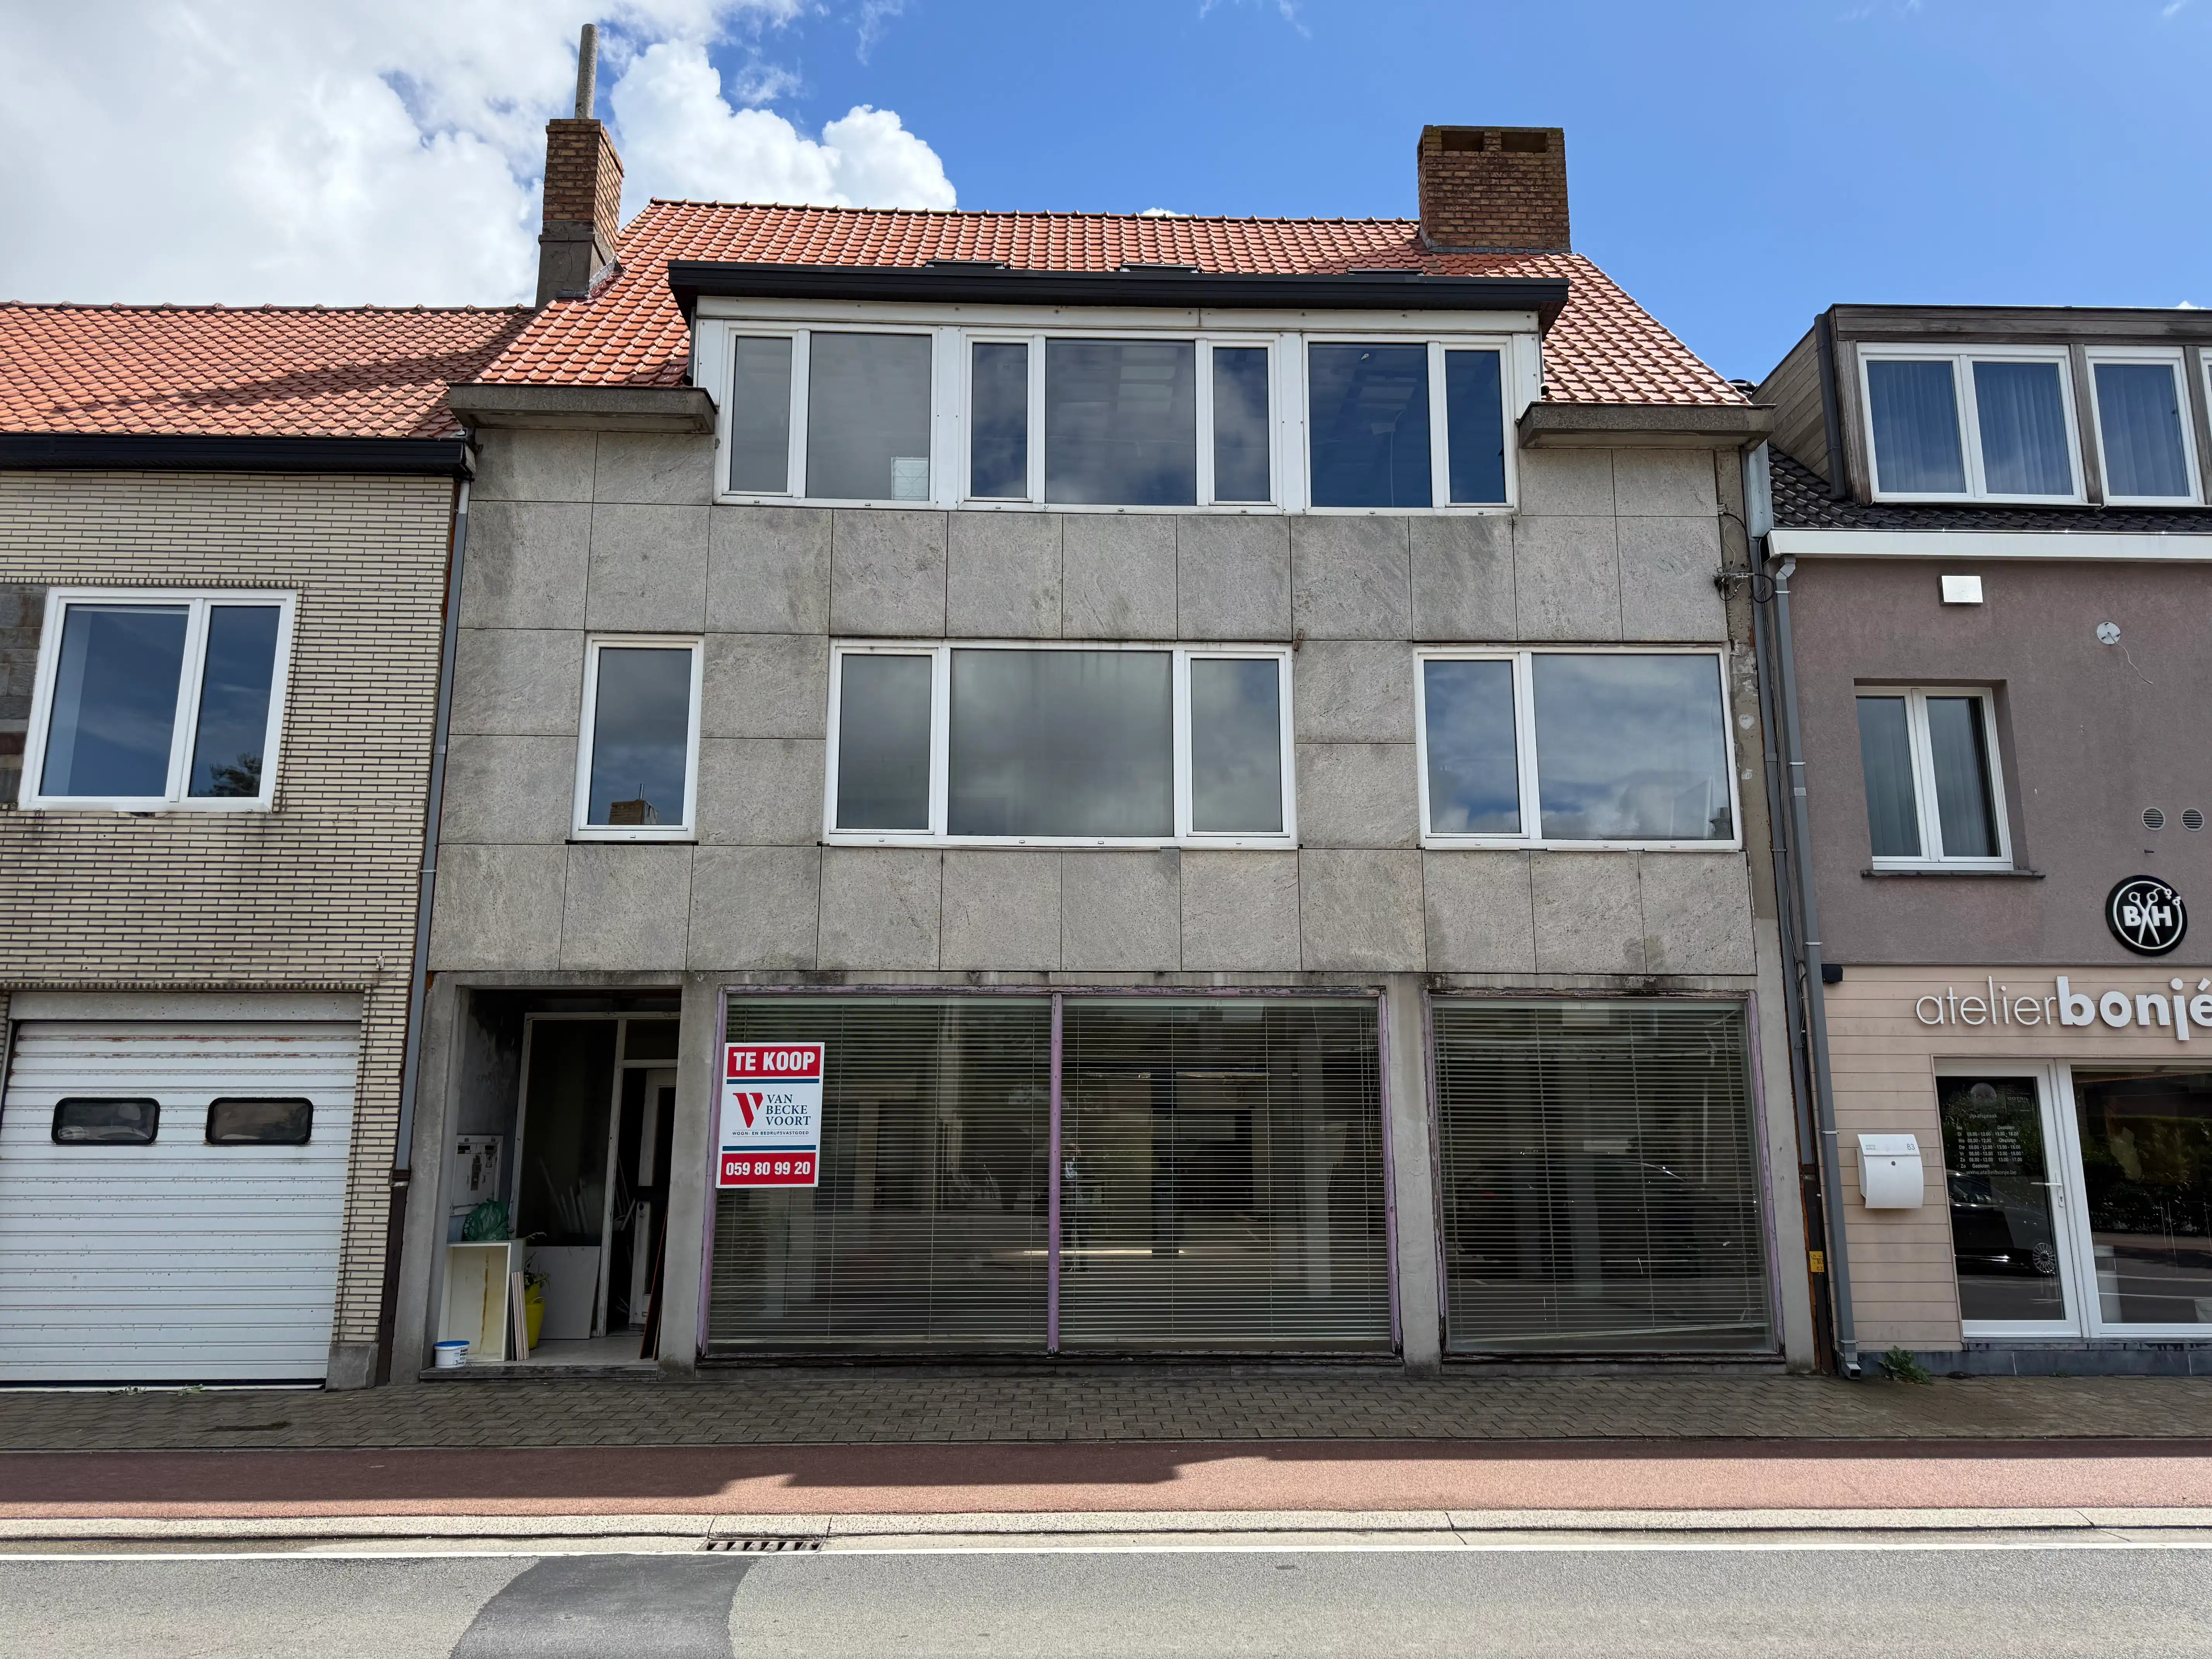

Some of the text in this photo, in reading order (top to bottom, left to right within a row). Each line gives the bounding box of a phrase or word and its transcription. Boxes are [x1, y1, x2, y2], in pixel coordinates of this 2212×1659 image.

[733, 1051, 815, 1071] TE KOOP
[767, 1094, 793, 1103] VAN
[766, 1105, 808, 1115] BECKE
[765, 1116, 811, 1125] VOORT
[726, 1161, 811, 1176] 059 80 99 20
